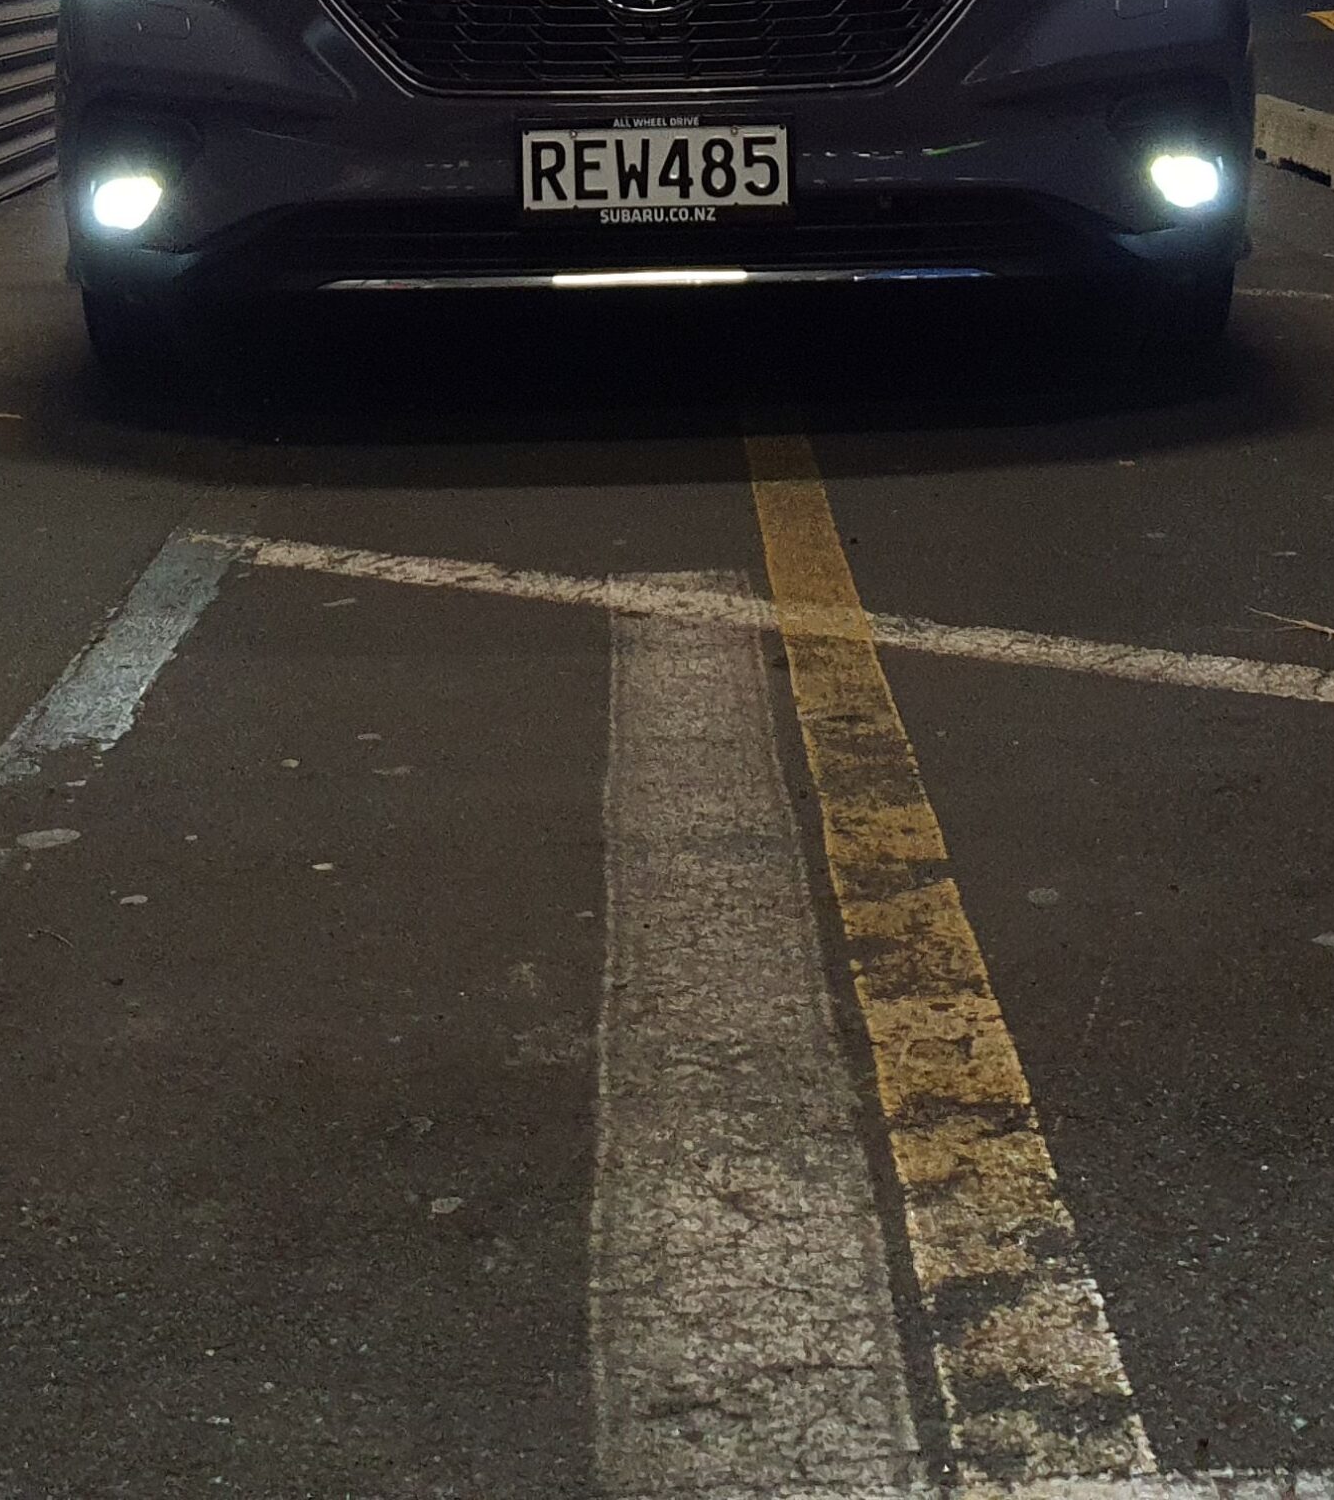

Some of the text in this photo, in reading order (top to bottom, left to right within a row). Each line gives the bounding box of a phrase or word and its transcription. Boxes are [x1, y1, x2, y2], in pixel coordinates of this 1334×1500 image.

[613, 116, 700, 128] ALL WHEEL DRIVE
[531, 136, 780, 200] REW485
[600, 206, 716, 223] SUBARU.CO.NZ
